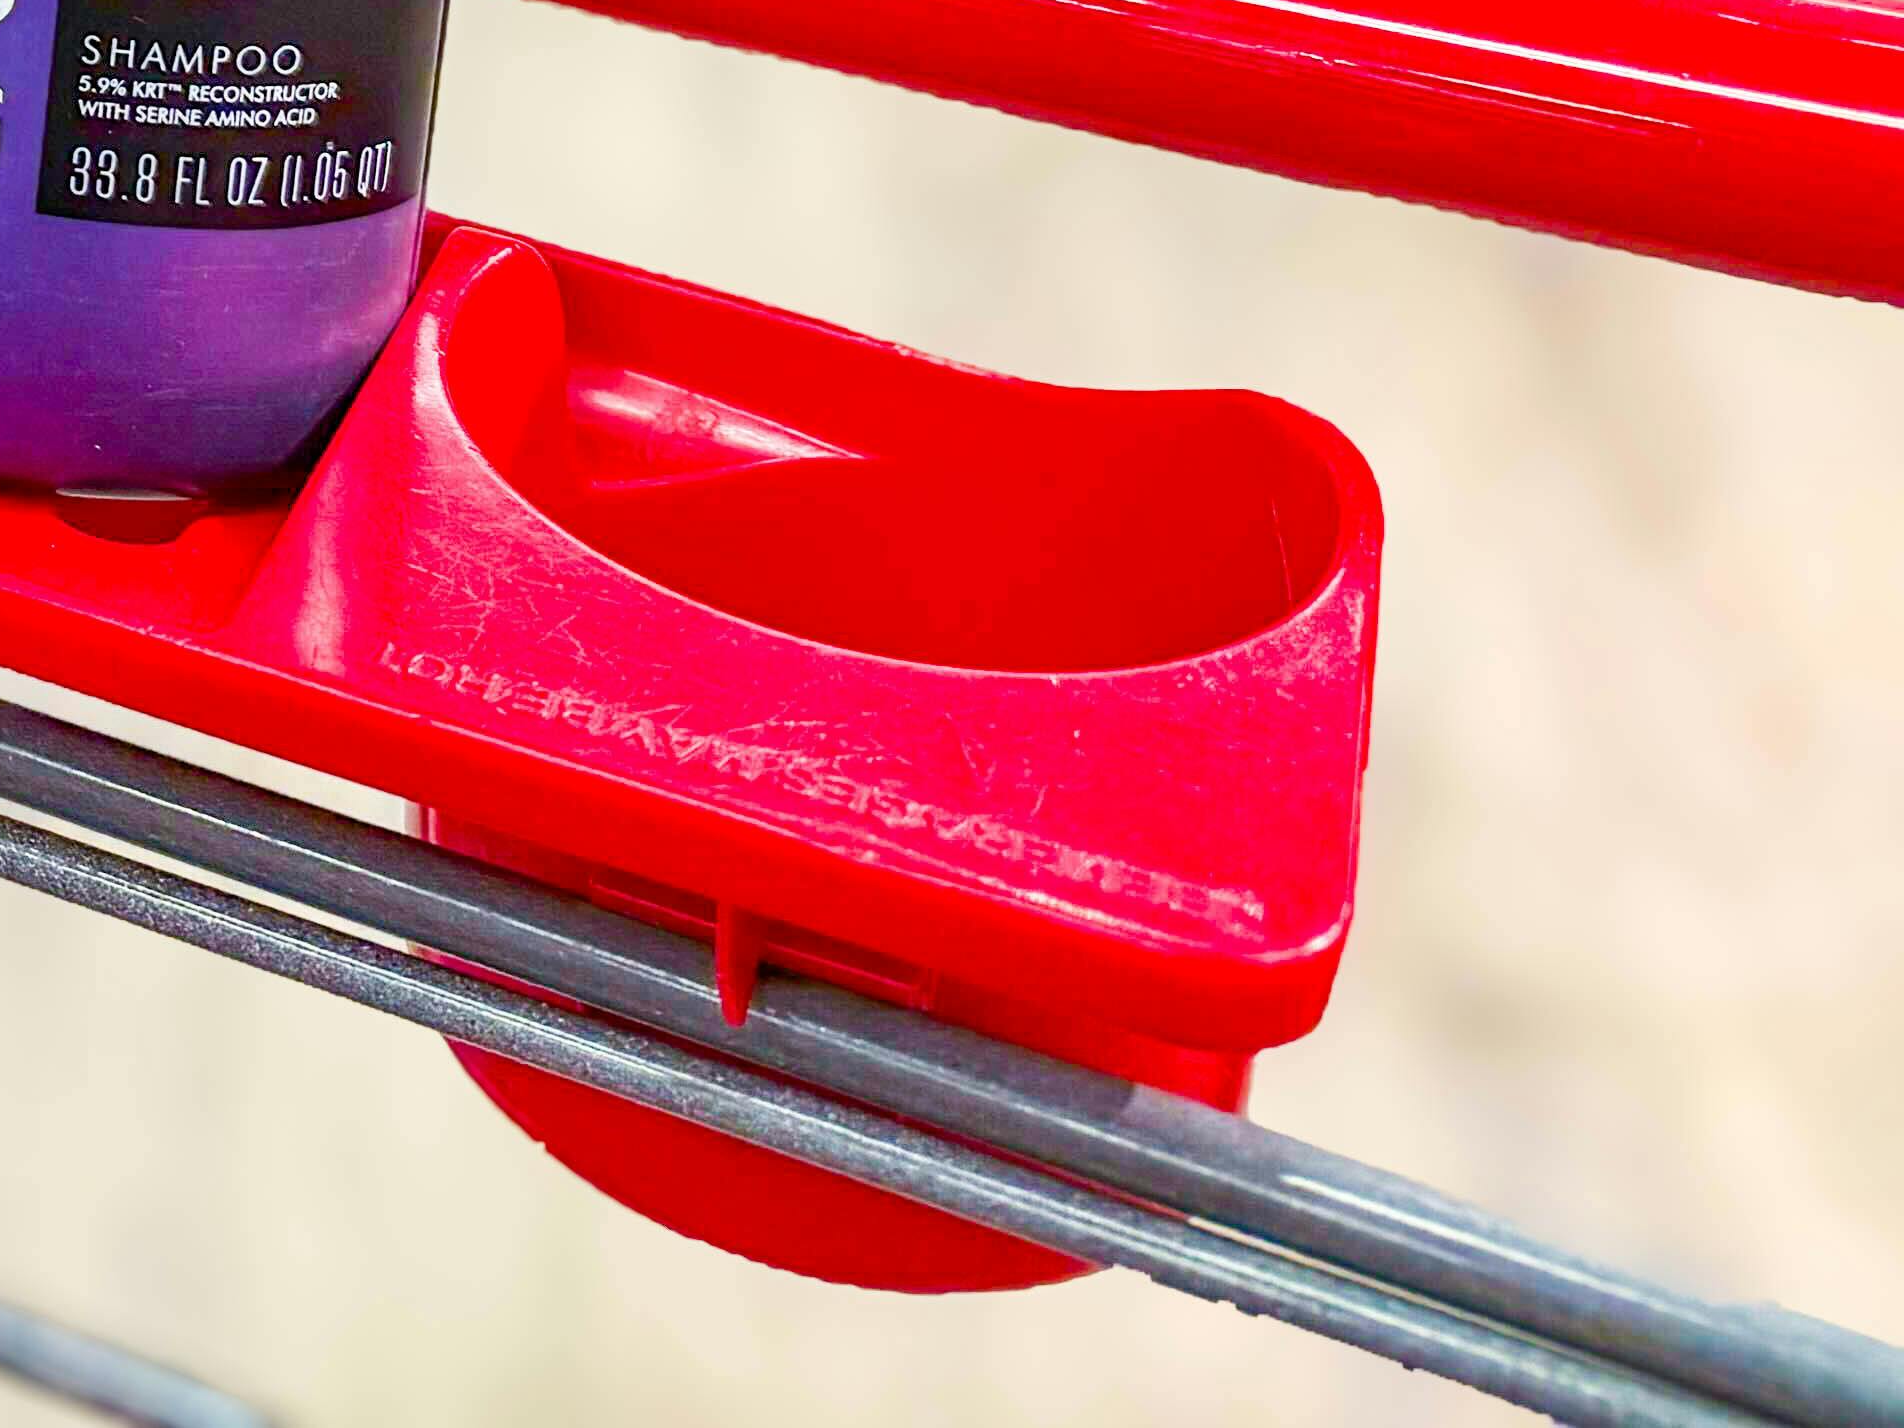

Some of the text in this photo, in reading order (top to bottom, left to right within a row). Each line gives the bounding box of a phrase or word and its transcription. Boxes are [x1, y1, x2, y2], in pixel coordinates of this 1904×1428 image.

[81, 34, 304, 76] SHAMPOO
[78, 75, 127, 96] 5.9%
[188, 82, 339, 104] RECONSTRUCTOR
[78, 100, 318, 127] WITH SERINE AMINO ACID
[69, 141, 393, 208] 33.8 FL OZ (1.05 QT)
